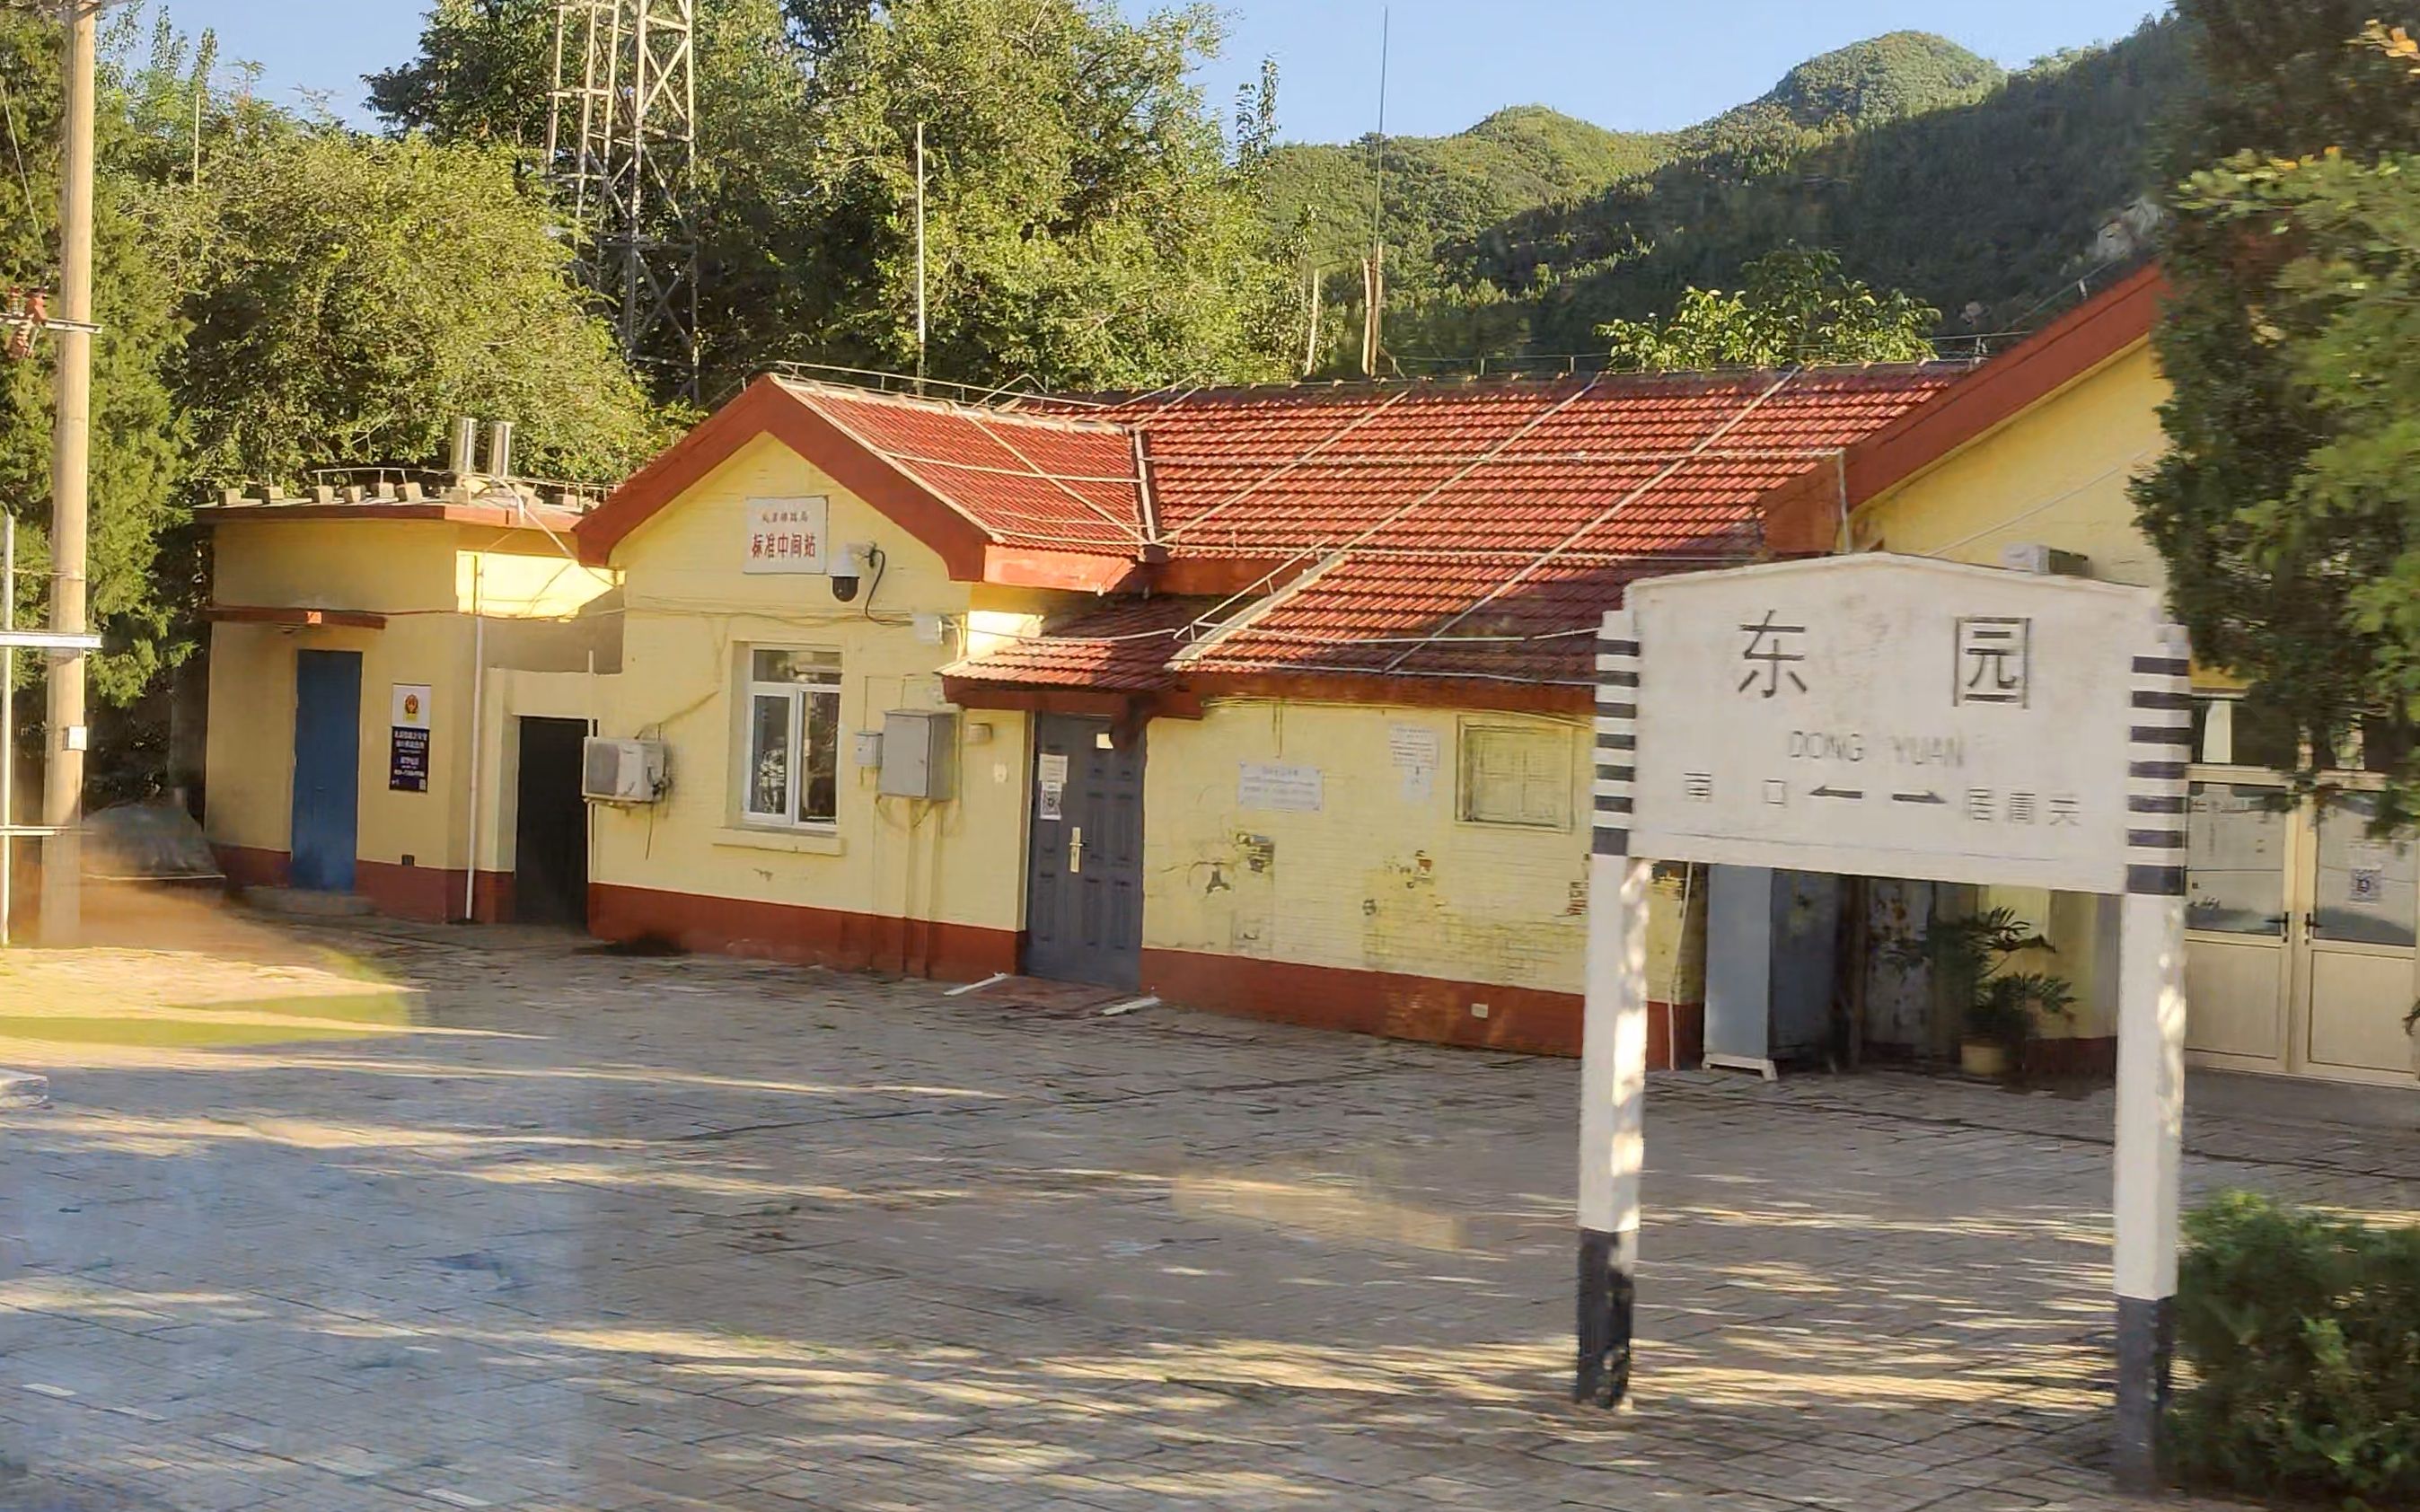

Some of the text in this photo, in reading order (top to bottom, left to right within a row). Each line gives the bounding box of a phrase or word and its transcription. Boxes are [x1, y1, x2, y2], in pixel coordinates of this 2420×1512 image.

[752, 532, 815, 558] 标准中间站
[1738, 609, 2032, 709] 东园
[1789, 730, 1964, 768] DONG YUAN
